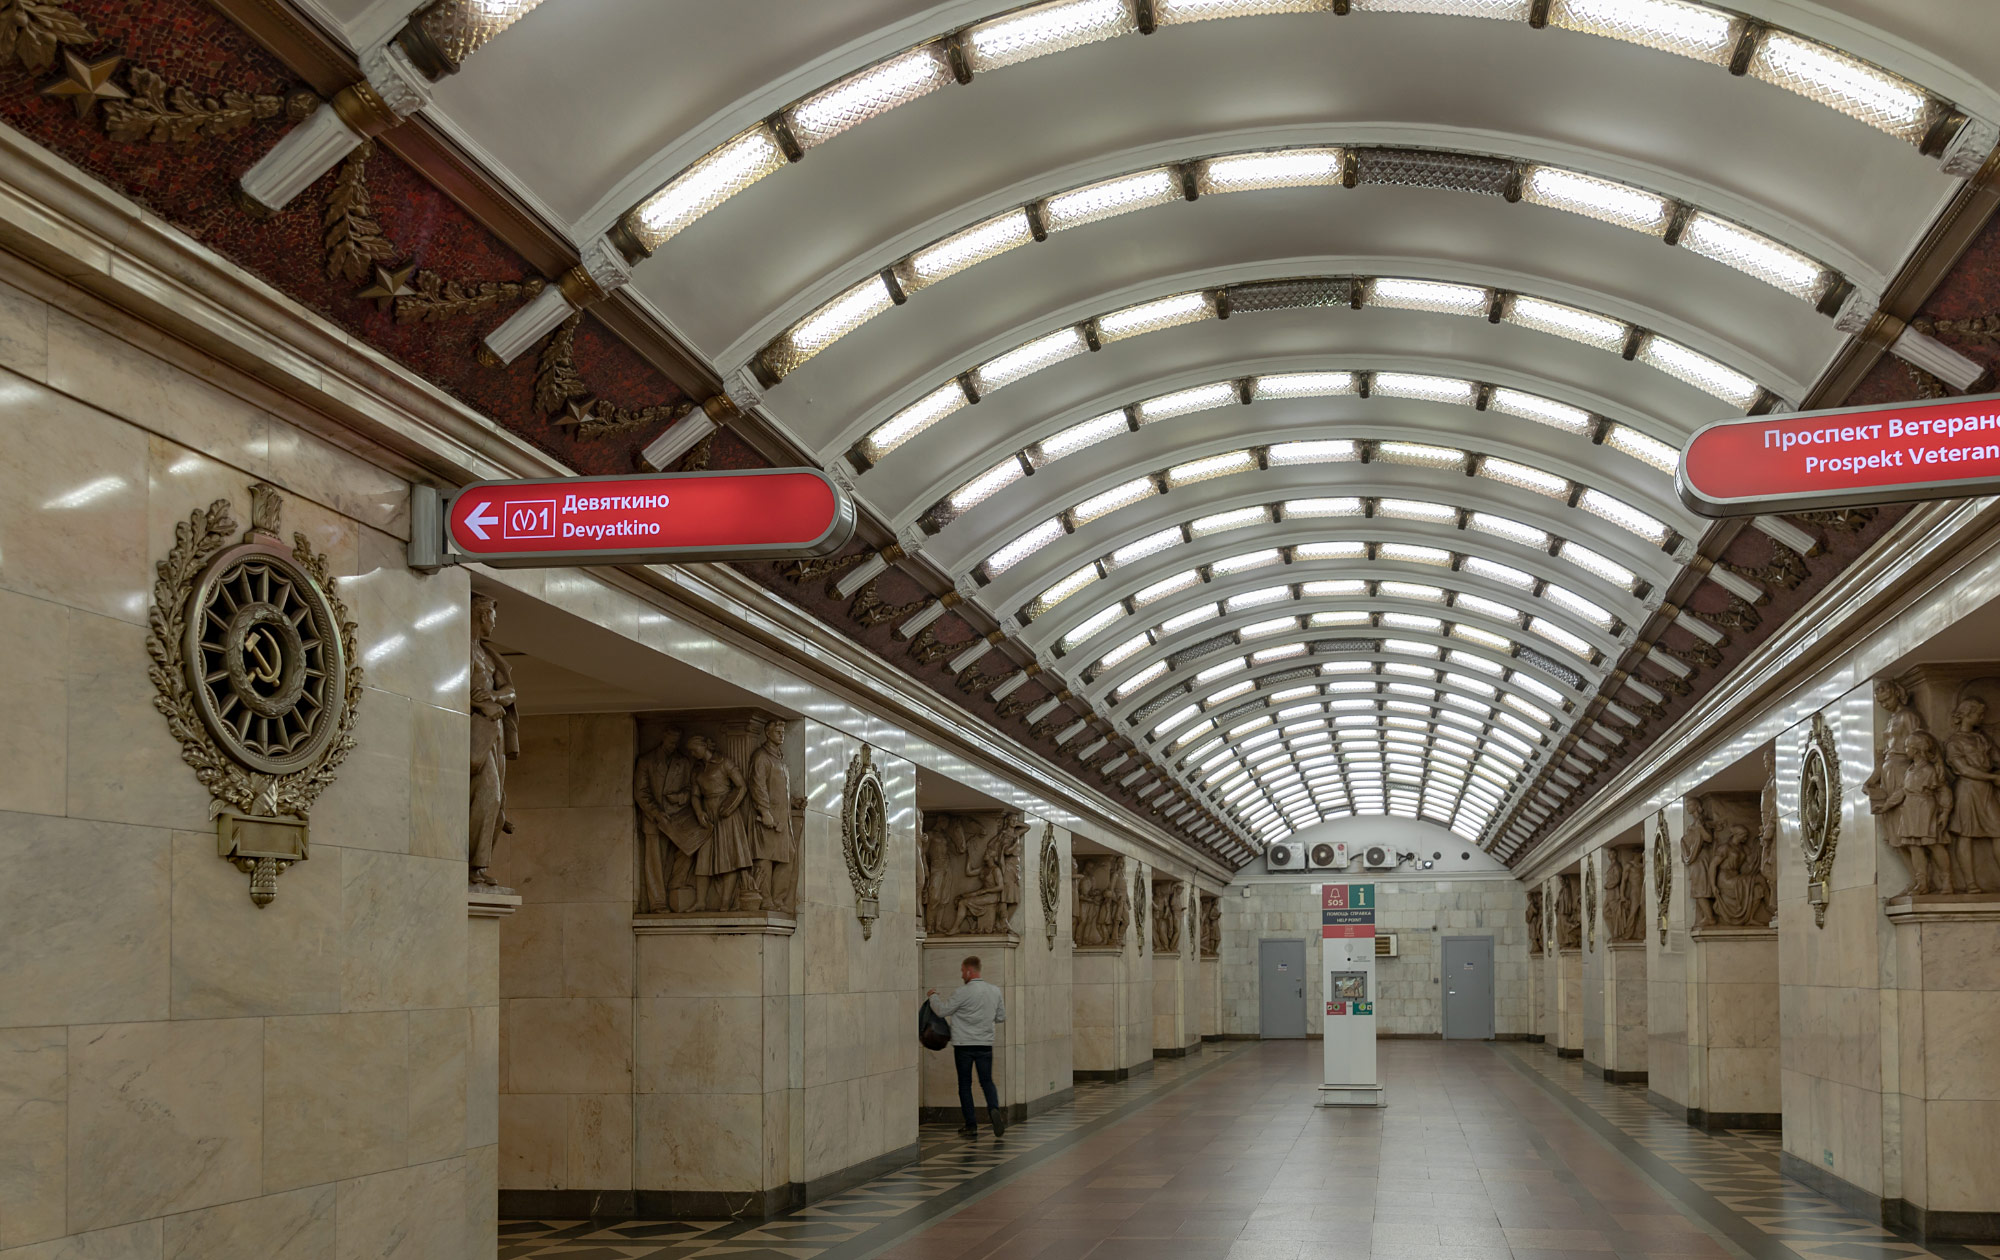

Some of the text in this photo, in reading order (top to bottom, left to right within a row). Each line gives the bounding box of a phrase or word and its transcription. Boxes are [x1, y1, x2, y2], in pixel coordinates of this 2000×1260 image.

[1764, 414, 2000, 452] Проспект Ветеран
[1805, 449, 1903, 474] Prospekt
[563, 494, 670, 515] Девяткино
[563, 520, 661, 541] Devyatkino
